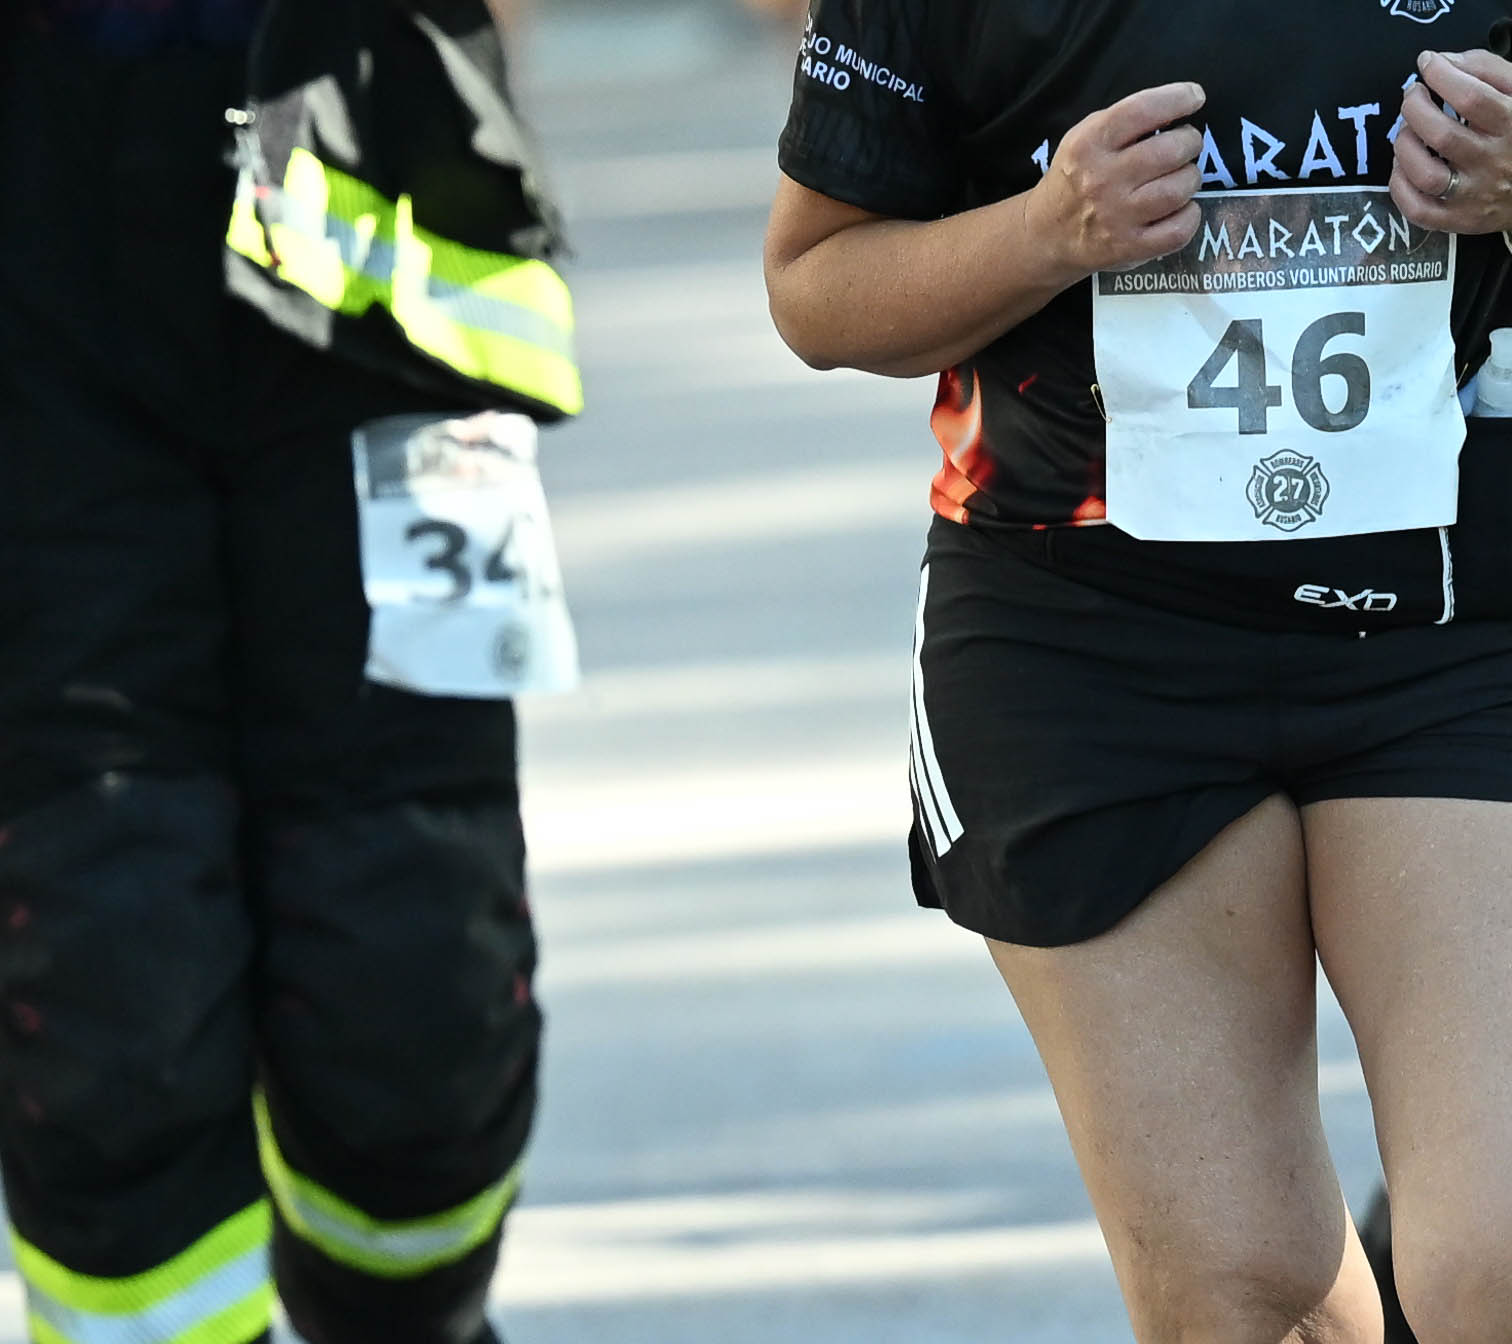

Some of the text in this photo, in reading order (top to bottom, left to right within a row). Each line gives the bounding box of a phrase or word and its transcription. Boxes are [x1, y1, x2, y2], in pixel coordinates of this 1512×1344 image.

[834, 44, 925, 103] MUNICIPAL
[1198, 201, 1410, 262] MARATÓN
[1202, 270, 1287, 291] BOMBEROS
[1289, 264, 1387, 286] VOLUNTARIOS
[1389, 261, 1443, 280] ROSARIO
[1187, 311, 1370, 435] 46
[1272, 475, 1304, 503] 27
